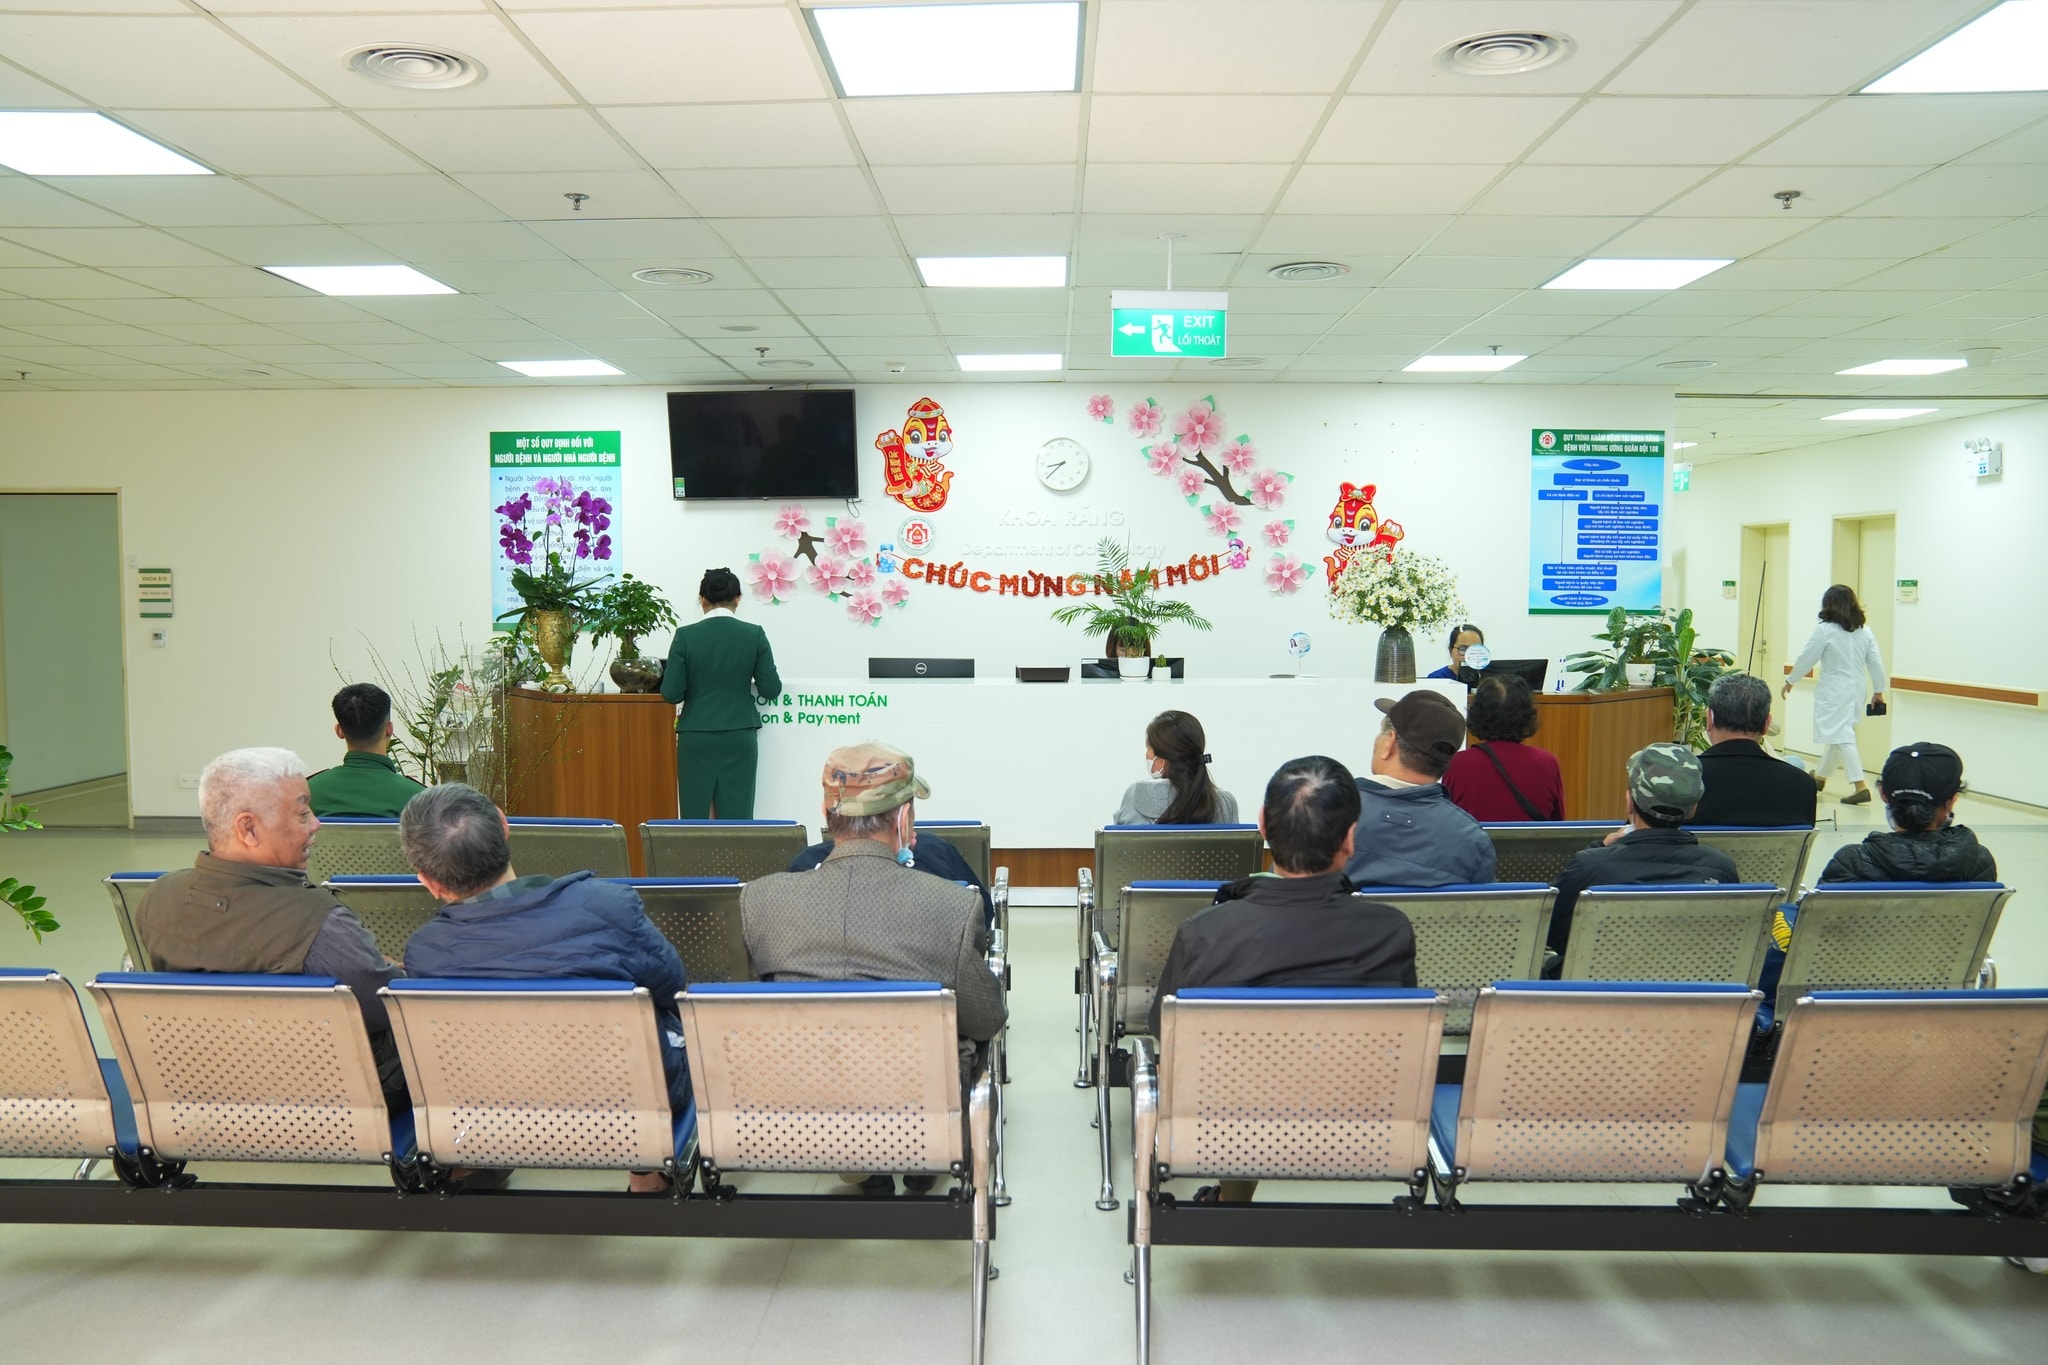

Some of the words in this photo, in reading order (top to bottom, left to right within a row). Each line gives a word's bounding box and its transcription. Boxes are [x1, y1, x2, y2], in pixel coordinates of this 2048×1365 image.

[1184, 316, 1215, 328] EXIT
[1178, 333, 1192, 345] LỐI
[1194, 334, 1221, 346] THOÁT
[516, 437, 529, 449] MỘT
[531, 436, 540, 448] SỐ
[541, 439, 553, 448] QUY
[554, 438, 570, 450] ĐỊNH
[571, 436, 582, 448] ĐỐI
[495, 452, 514, 463] NGƯỜI
[515, 452, 532, 465] BỆNH
[533, 452, 542, 463] VÀ
[543, 452, 562, 463] NGƯỜI
[564, 452, 576, 463] NHÀ
[578, 452, 597, 463] NGƯỜI
[599, 452, 616, 464] BỆNH
[998, 510, 1056, 527] KHOA
[1065, 504, 1126, 527] RĂNG
[902, 557, 992, 592] CHÚC
[1000, 570, 1086, 596] MỪNG
[1166, 554, 1219, 586] MỚI
[782, 694, 792, 706] &
[798, 694, 844, 706] THANH
[849, 692, 888, 706] TOÁN
[784, 712, 793, 723] &
